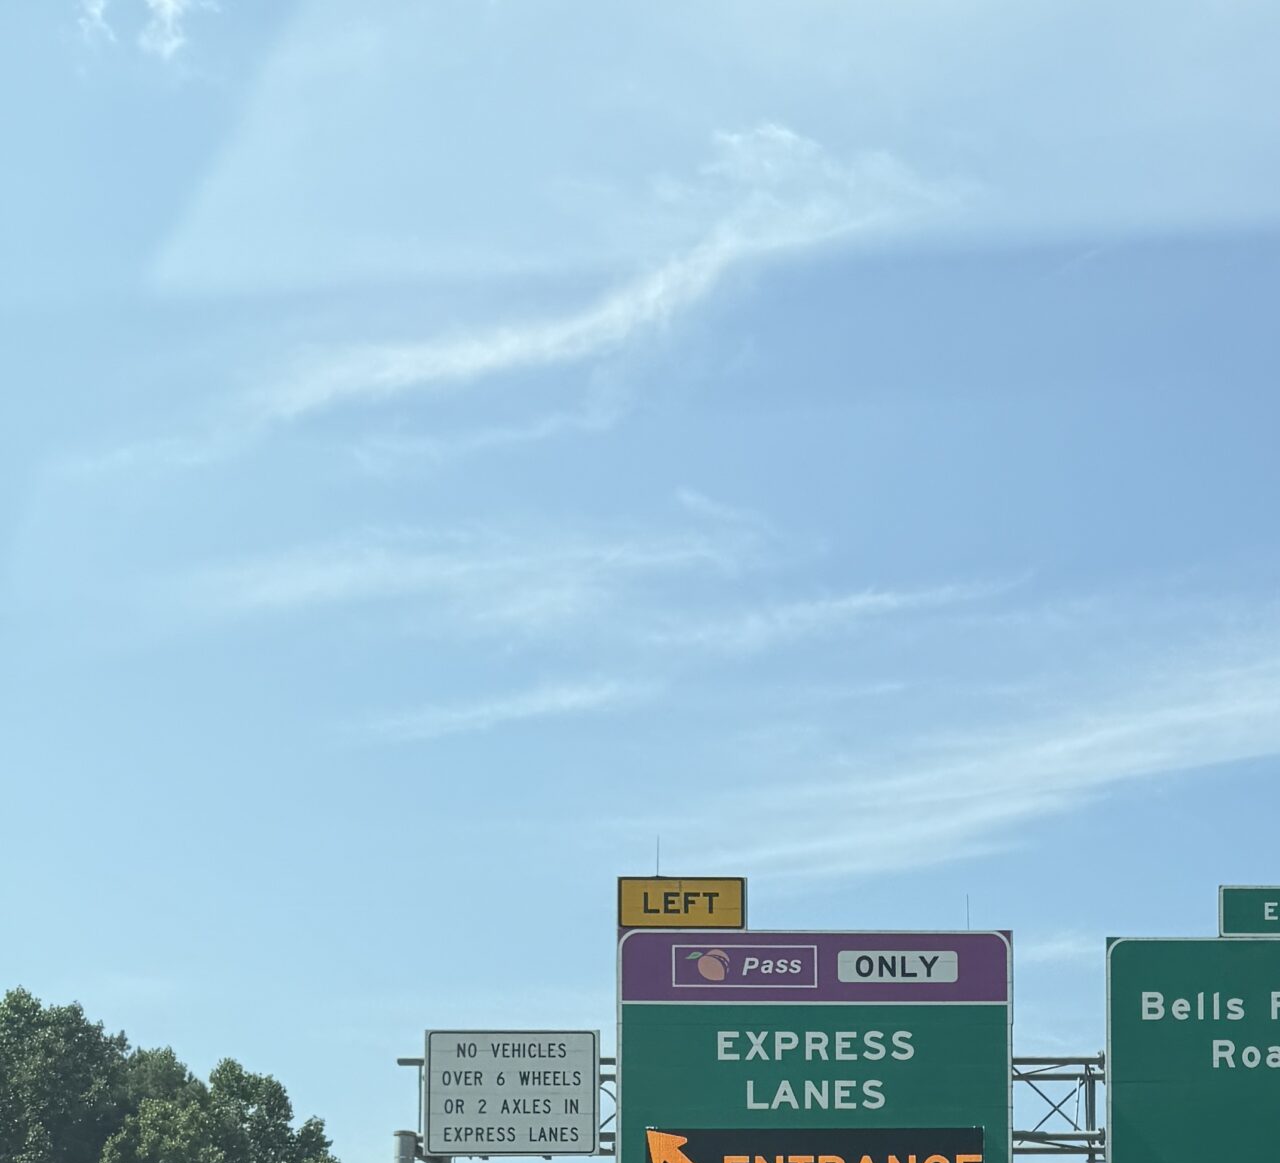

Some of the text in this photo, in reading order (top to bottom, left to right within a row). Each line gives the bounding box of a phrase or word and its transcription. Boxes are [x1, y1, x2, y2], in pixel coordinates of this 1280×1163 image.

[643, 891, 720, 915] LEFT
[742, 957, 802, 976] Pass
[854, 955, 940, 978] ONLY
[1141, 991, 1245, 1021] Bells
[456, 1042, 567, 1059] NO VEHICLES
[717, 1030, 915, 1061] EXPRESS
[441, 1070, 581, 1087] OVER 6 WHEELS
[746, 1079, 886, 1110] LANES
[444, 1098, 579, 1115] OR 2 AXLES IN
[443, 1126, 579, 1143] EXPRESS LANES
